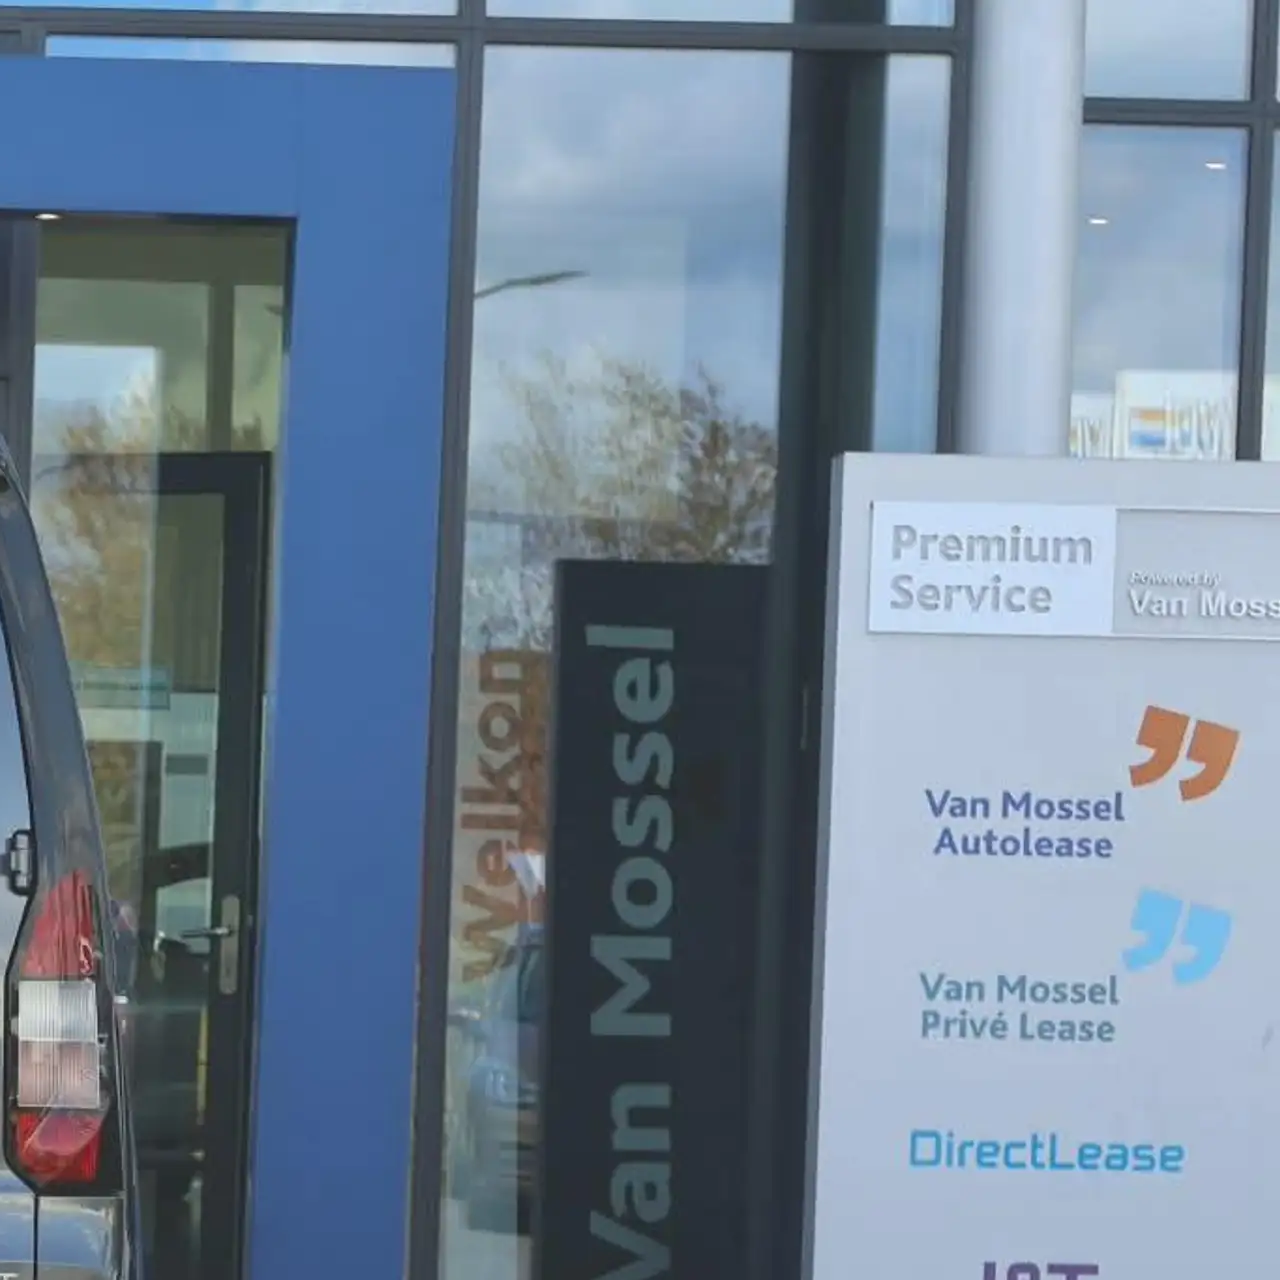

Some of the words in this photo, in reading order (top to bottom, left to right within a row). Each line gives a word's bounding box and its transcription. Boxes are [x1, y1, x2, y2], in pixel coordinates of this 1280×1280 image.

[891, 524, 1094, 566] Premium
[888, 573, 1053, 614] Service
[1129, 589, 1188, 617] Van
[924, 788, 990, 820] Van
[1002, 791, 1126, 823] Mossel
[586, 624, 675, 1037] Mossel
[932, 827, 1115, 860] Autolease
[919, 972, 984, 1003] Van
[997, 974, 1120, 1006] Mossel
[920, 1009, 1009, 1041] Privé
[1019, 1012, 1116, 1043] Lease
[908, 1129, 1186, 1174] DirectLease
